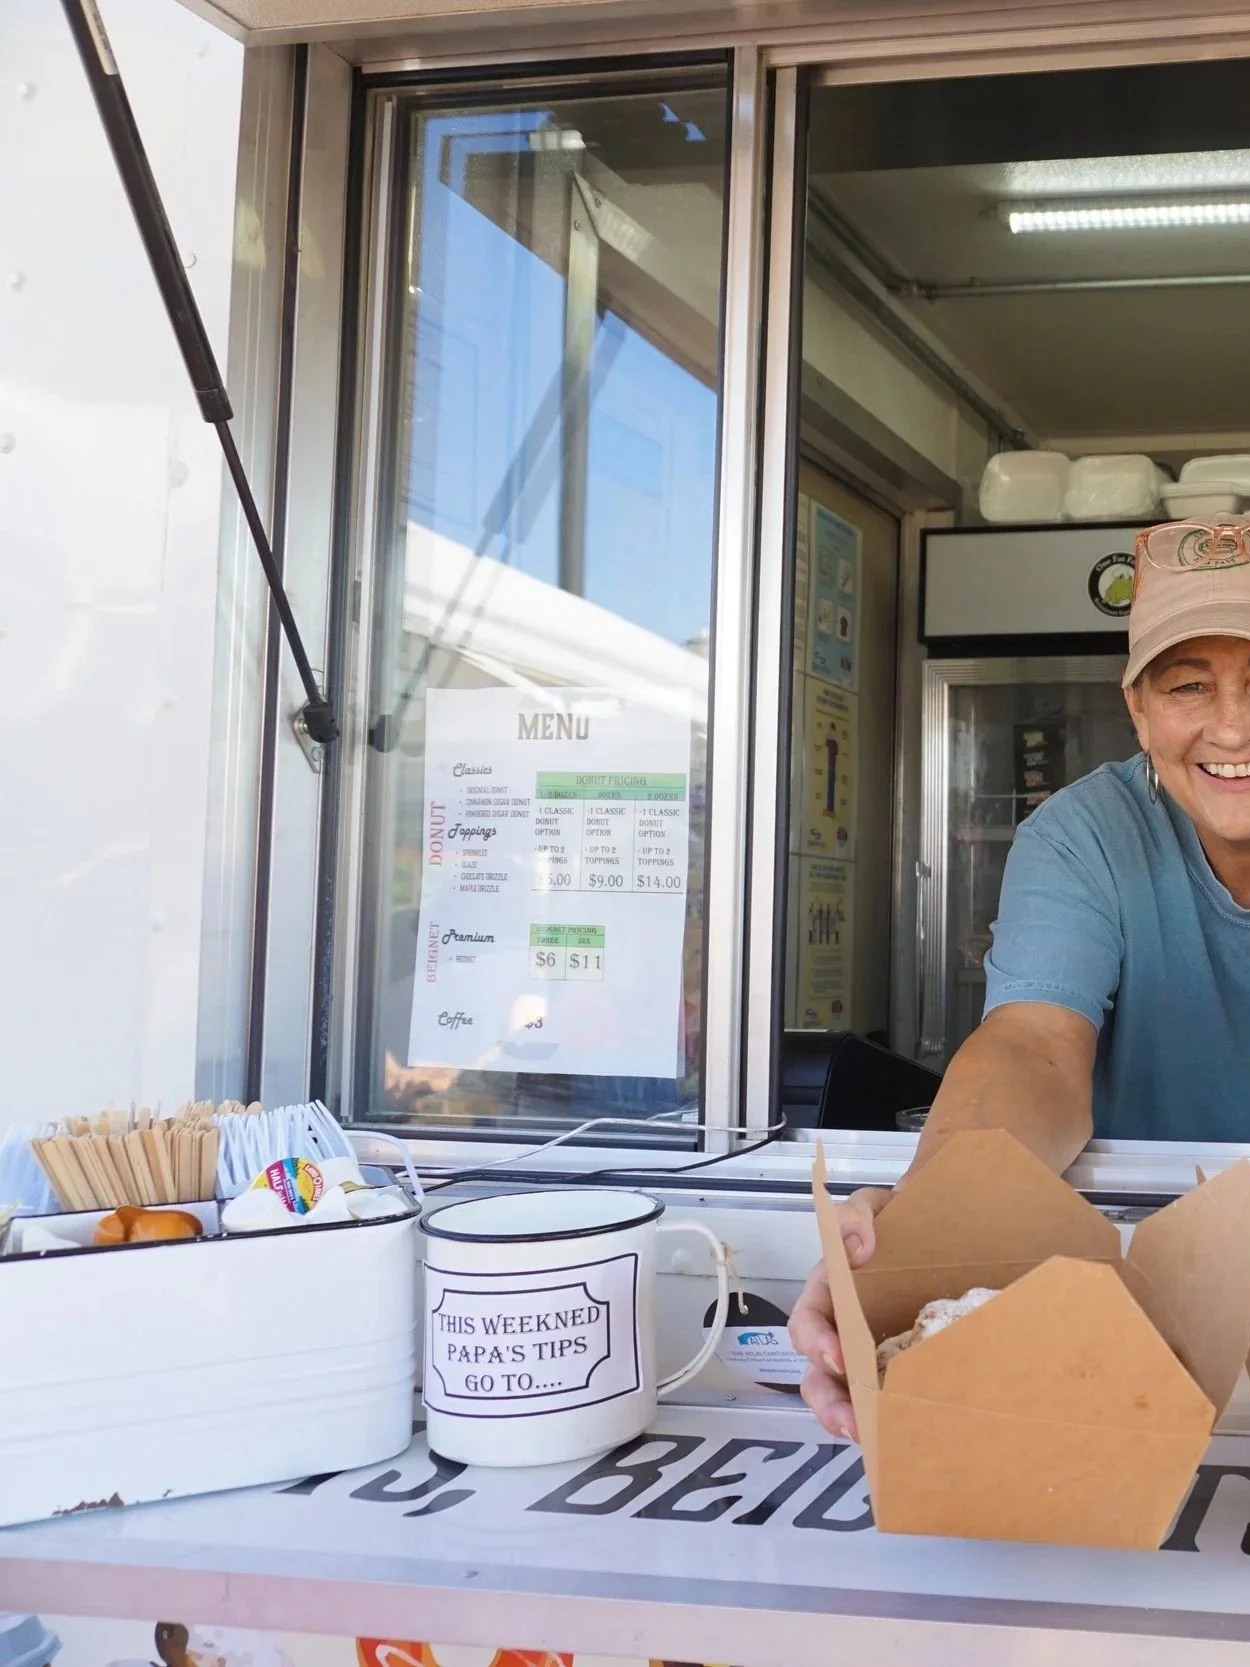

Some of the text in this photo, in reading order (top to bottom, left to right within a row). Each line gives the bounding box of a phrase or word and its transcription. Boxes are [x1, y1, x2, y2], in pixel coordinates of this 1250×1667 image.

[516, 712, 589, 740] MENU
[452, 762, 492, 777] Classics
[576, 776, 648, 786] DONUT PRICING
[493, 798, 509, 806] SUGAR
[512, 798, 531, 806] DONUT
[492, 810, 509, 818] SUGAR
[510, 810, 530, 818] DONUT
[429, 800, 446, 866] DONUT
[448, 823, 496, 841] Toppings
[639, 830, 666, 838] OPTION
[585, 857, 620, 865] TOPPINGS
[638, 858, 674, 866] TOPPINGS
[486, 873, 508, 881] DRIZZLE
[589, 874, 623, 888] $9.00
[637, 875, 681, 888] $14.00
[460, 884, 500, 892] MAPLE DRIZZLE
[442, 929, 495, 945] Premium
[568, 926, 597, 934] PRICING
[578, 937, 591, 945] SIX
[427, 921, 440, 983] BEIGNET
[536, 952, 556, 968] $6
[569, 953, 601, 969] $11
[438, 1011, 474, 1030] Coffee
[269, 1168, 284, 1192] HALF
[438, 1305, 600, 1335] THIS WEEKNED
[448, 1336, 588, 1364] PAPA'S TIPS
[465, 1374, 494, 1392] GO
